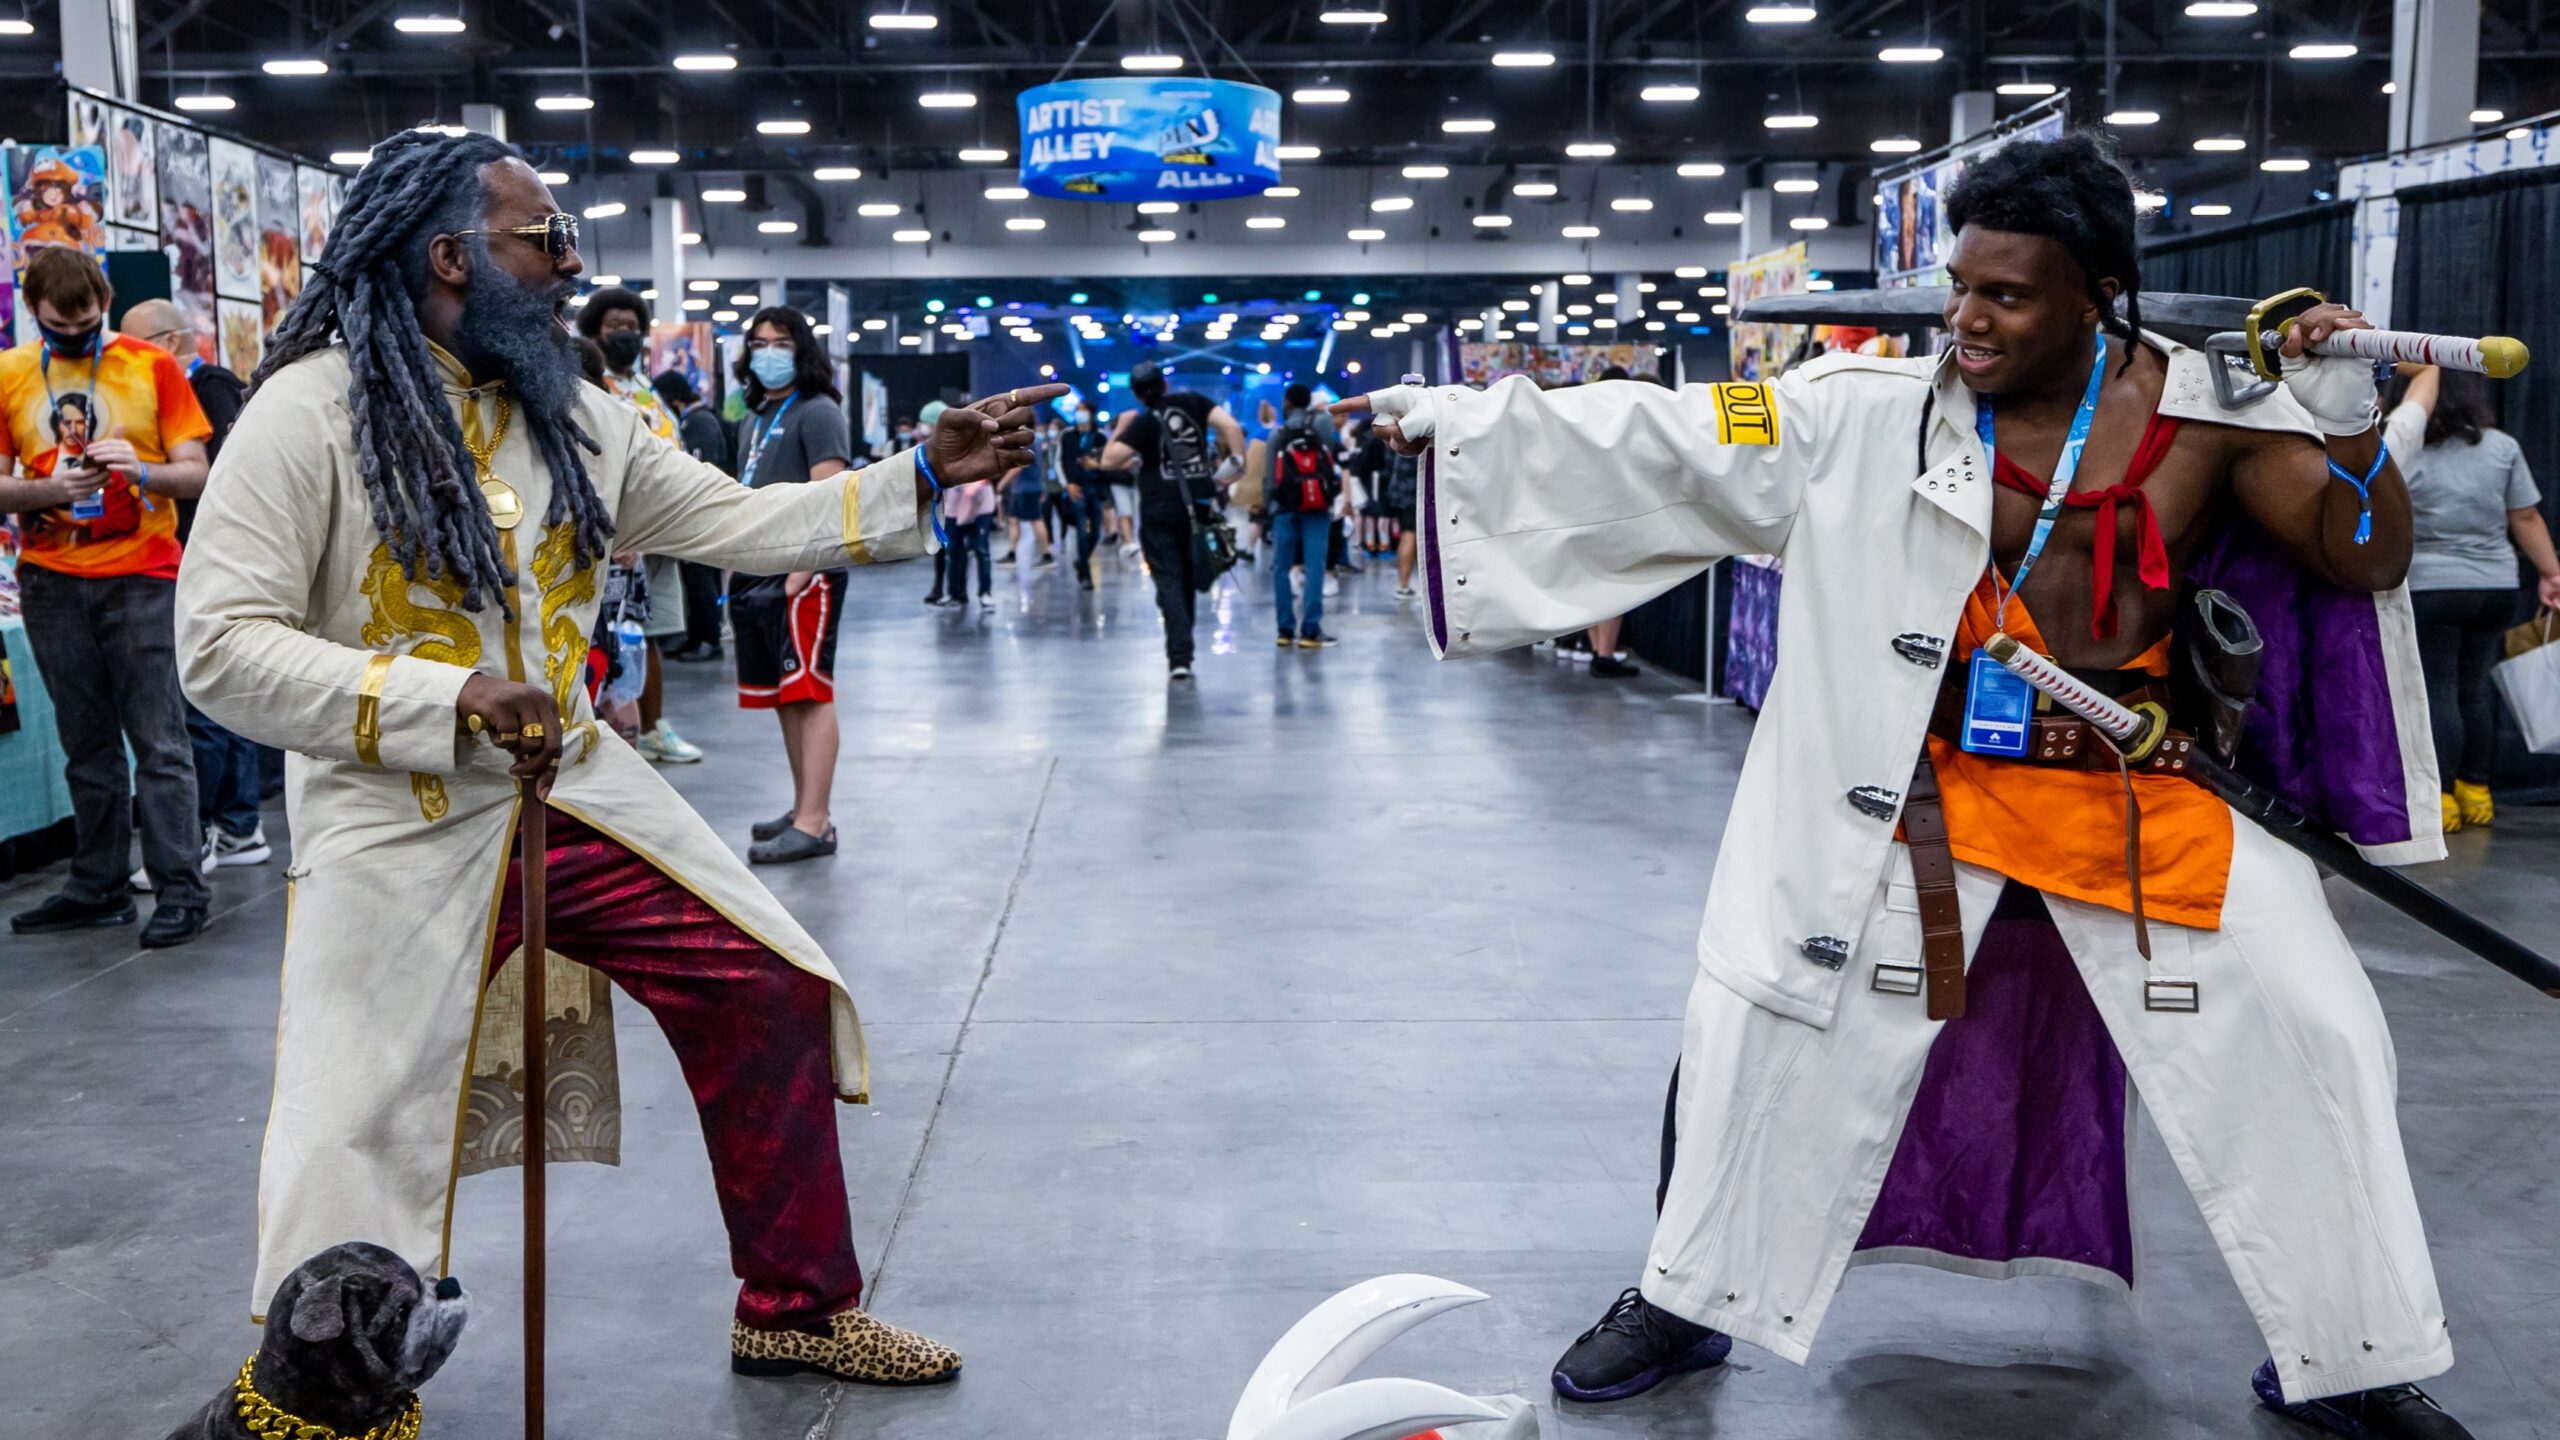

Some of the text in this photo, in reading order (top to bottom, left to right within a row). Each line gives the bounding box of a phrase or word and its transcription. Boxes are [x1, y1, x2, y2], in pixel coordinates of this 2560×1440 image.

[1028, 99, 1125, 134] ARTIST
[1029, 132, 1117, 166] ALLEY
[1726, 386, 1768, 434] OUT
